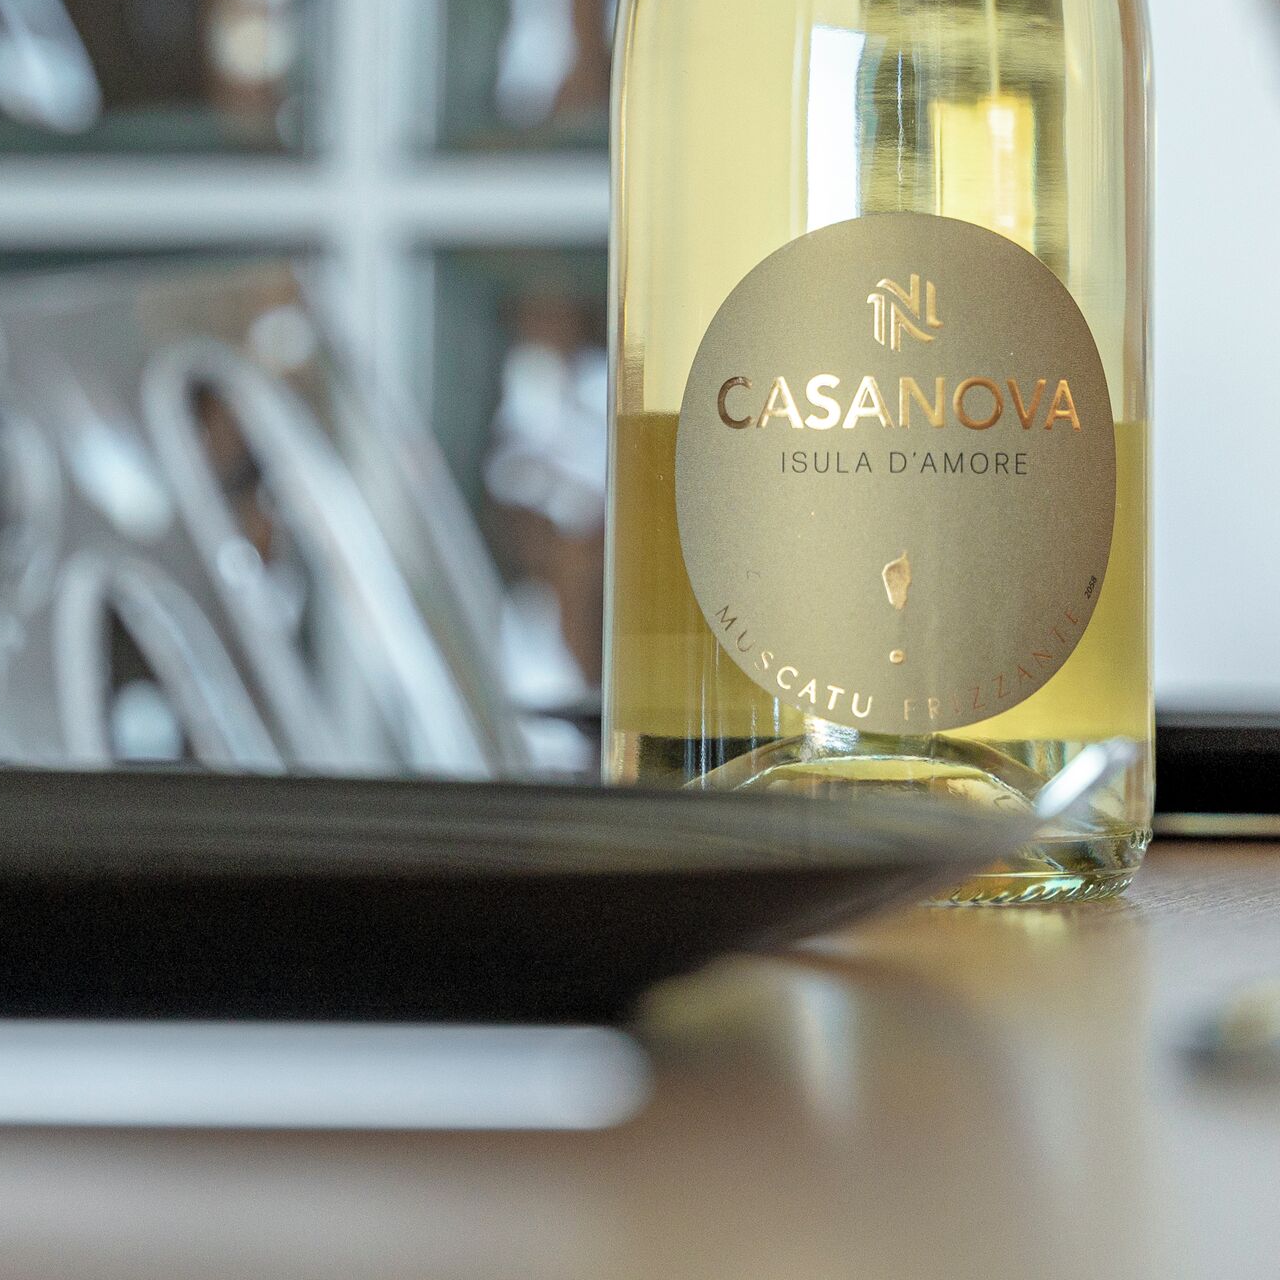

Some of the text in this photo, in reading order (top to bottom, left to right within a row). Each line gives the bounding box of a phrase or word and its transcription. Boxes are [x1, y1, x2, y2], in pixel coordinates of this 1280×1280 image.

[717, 373, 1081, 431] CASANOVA
[781, 451, 1028, 475] ISULA D'AMORE
[1084, 575, 1097, 600] 2058
[715, 604, 873, 718] MUSCATU
